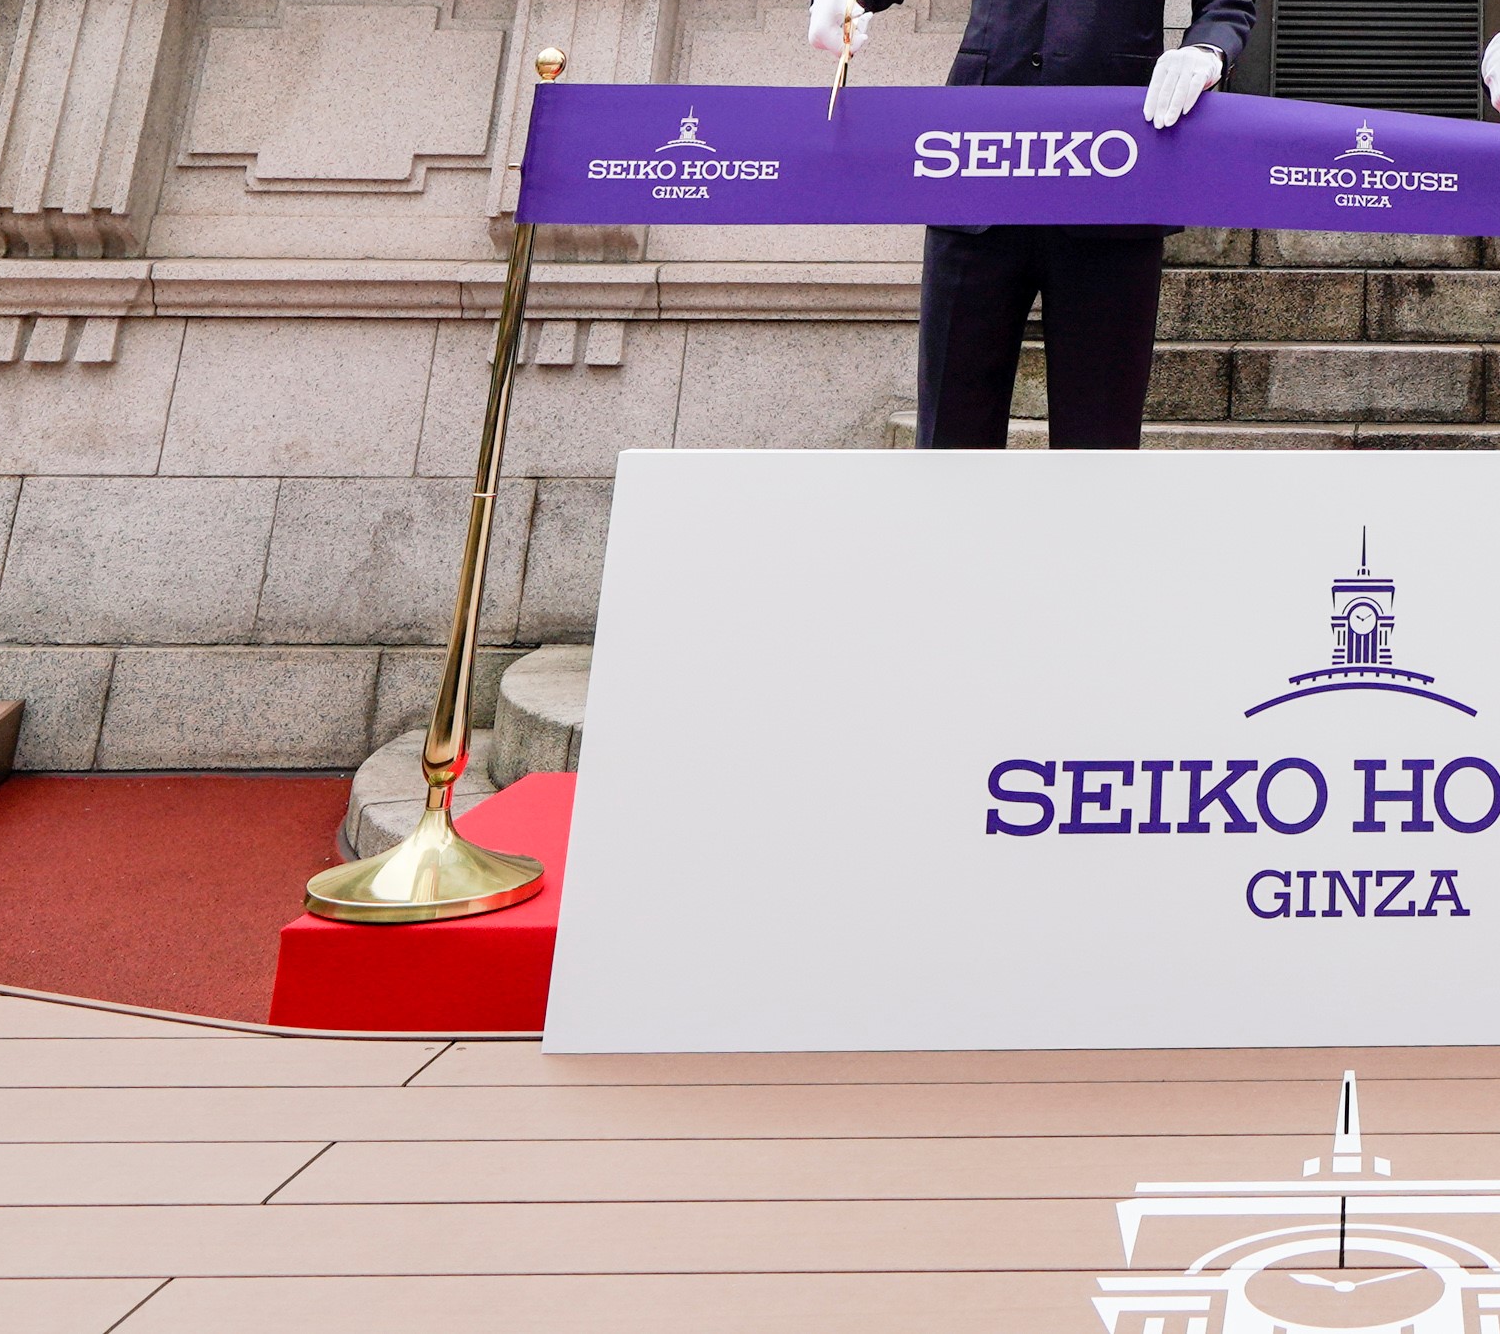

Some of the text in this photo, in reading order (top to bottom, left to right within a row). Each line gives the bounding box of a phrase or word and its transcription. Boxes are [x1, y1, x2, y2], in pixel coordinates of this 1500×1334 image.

[913, 130, 1139, 178] SEIKO
[587, 159, 780, 180] SEIKO HOUSE
[1269, 165, 1458, 192] SEIKO HOUSE
[651, 185, 710, 199] GINZA
[1334, 193, 1392, 208] GINZA
[985, 757, 1329, 837] SEIKO
[1246, 869, 1471, 920] GINZA
